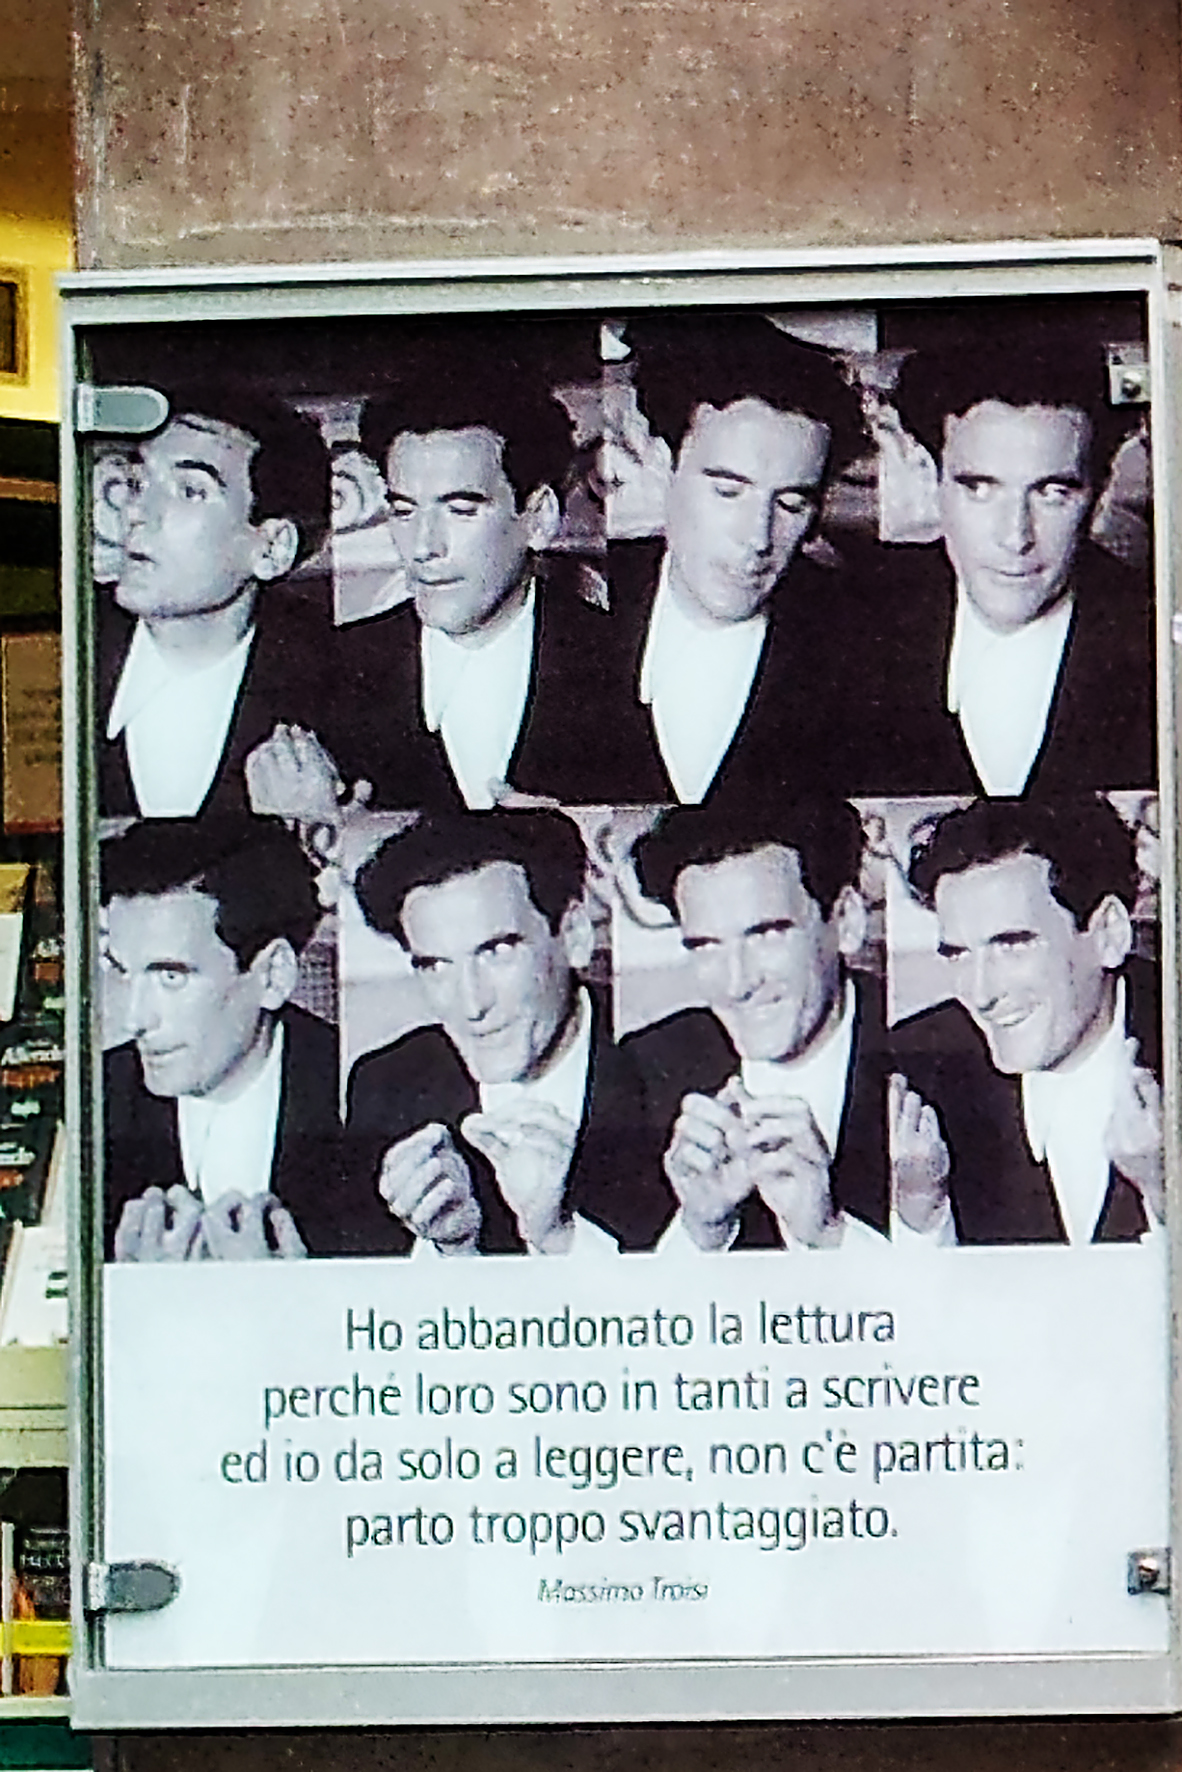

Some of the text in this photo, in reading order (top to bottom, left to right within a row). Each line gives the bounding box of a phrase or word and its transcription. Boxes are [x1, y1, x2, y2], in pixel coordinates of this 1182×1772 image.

[347, 1301, 895, 1351] Ho abbandonato la lettura
[265, 1362, 980, 1430] perché loro sono in tanti a scrivere
[220, 1428, 1024, 1490] ed io da solo a leggere, non c'è partita:
[347, 1495, 898, 1559] parto troppo svantaggiato.
[538, 1576, 709, 1603] Massimo Troisi
